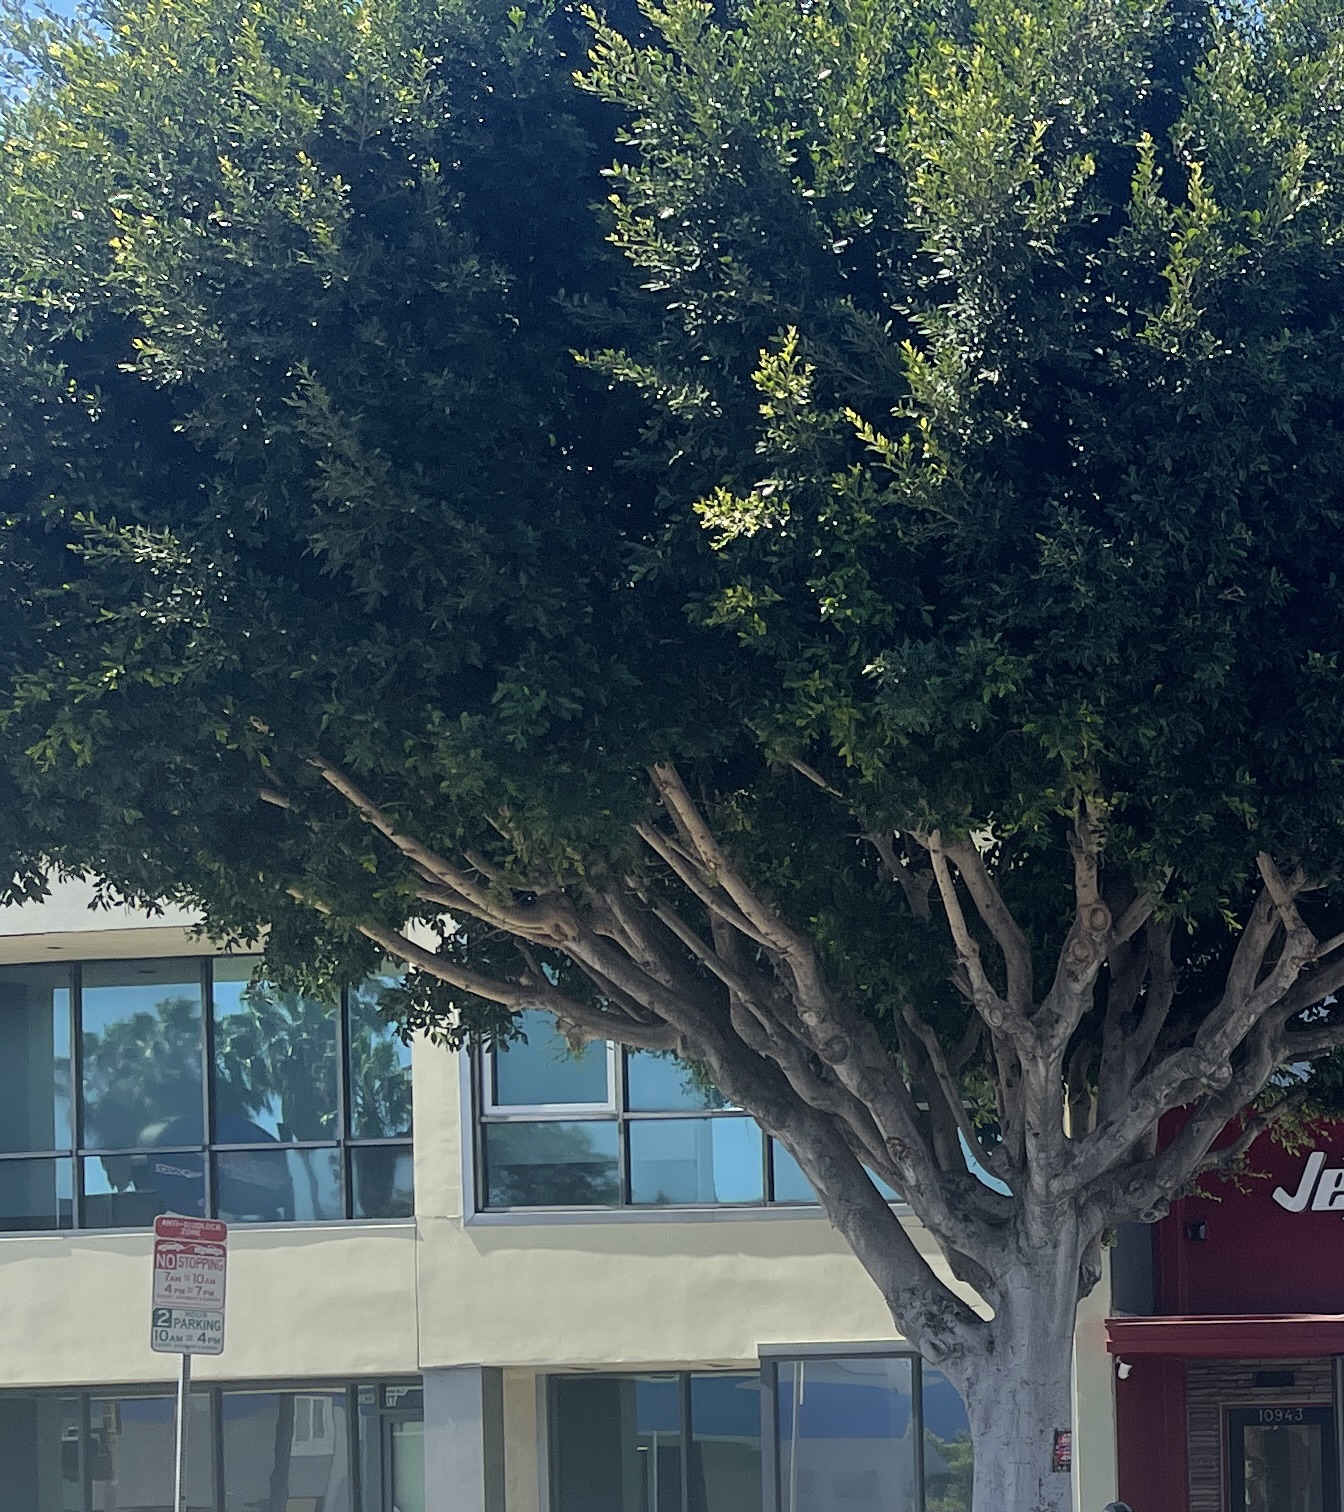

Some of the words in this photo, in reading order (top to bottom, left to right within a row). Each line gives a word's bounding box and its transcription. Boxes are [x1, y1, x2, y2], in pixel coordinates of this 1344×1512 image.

[156, 1254, 176, 1269] NO
[178, 1256, 224, 1271] STOPPING
[156, 1309, 170, 1326] 2
[173, 1318, 221, 1332] PARKING
[1259, 1407, 1304, 1422] 10943
